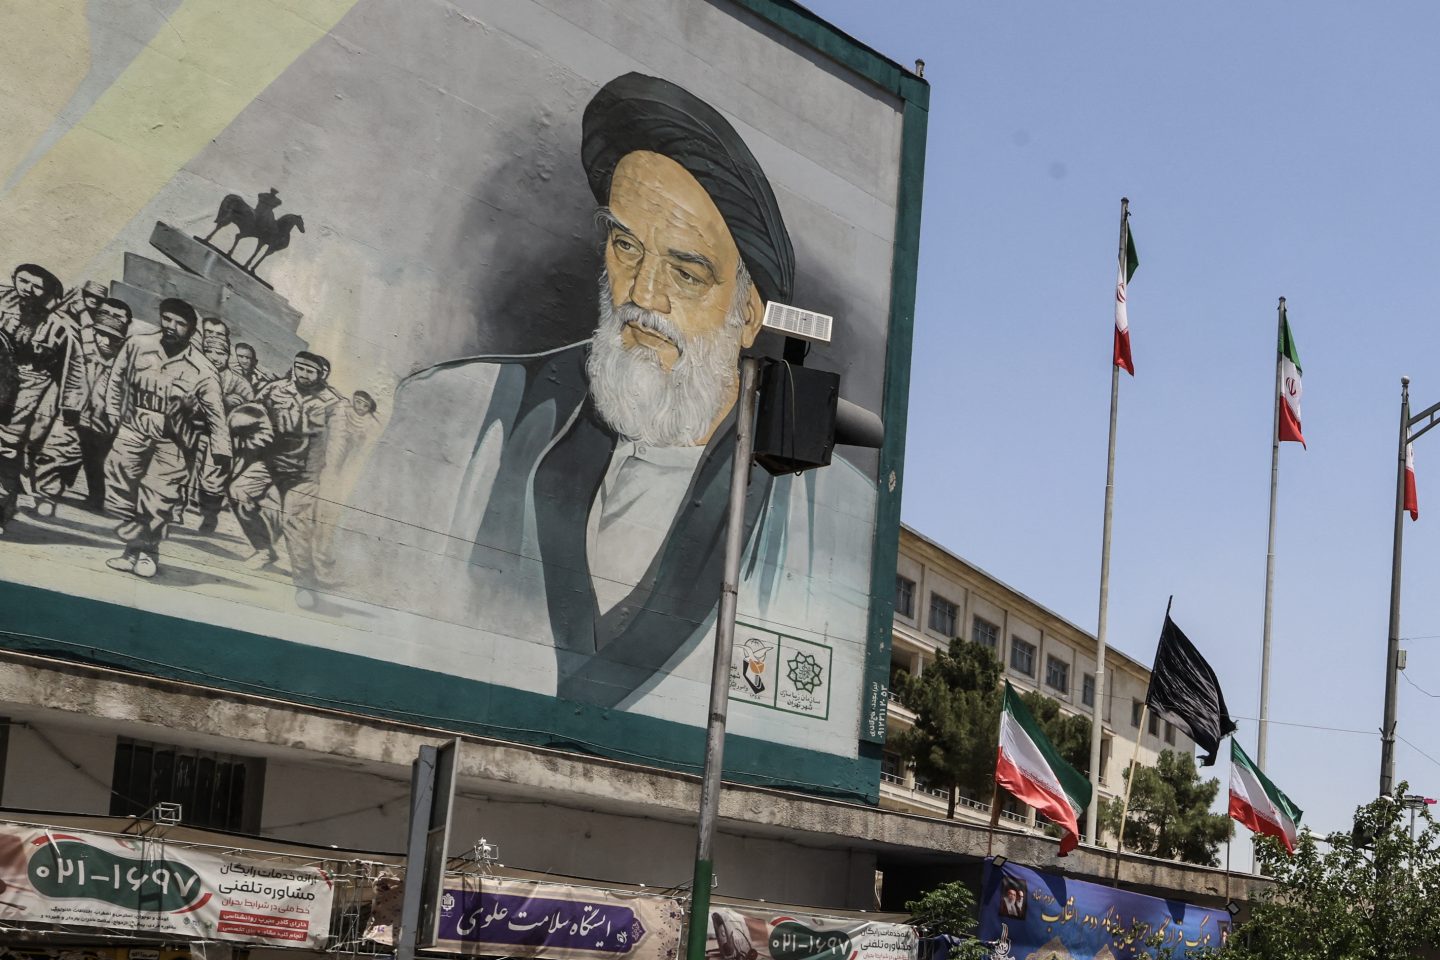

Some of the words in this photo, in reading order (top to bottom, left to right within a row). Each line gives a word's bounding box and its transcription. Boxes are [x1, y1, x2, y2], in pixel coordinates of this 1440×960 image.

[220, 863, 257, 878] رایگان
[258, 869, 295, 881] خدمات
[219, 880, 262, 895] تلفنی
[264, 886, 316, 901] مشاوره
[456, 902, 508, 935] علوی
[508, 911, 570, 934] سلامت
[570, 905, 611, 947] ایستگاه
[861, 940, 884, 951] تلفنی
